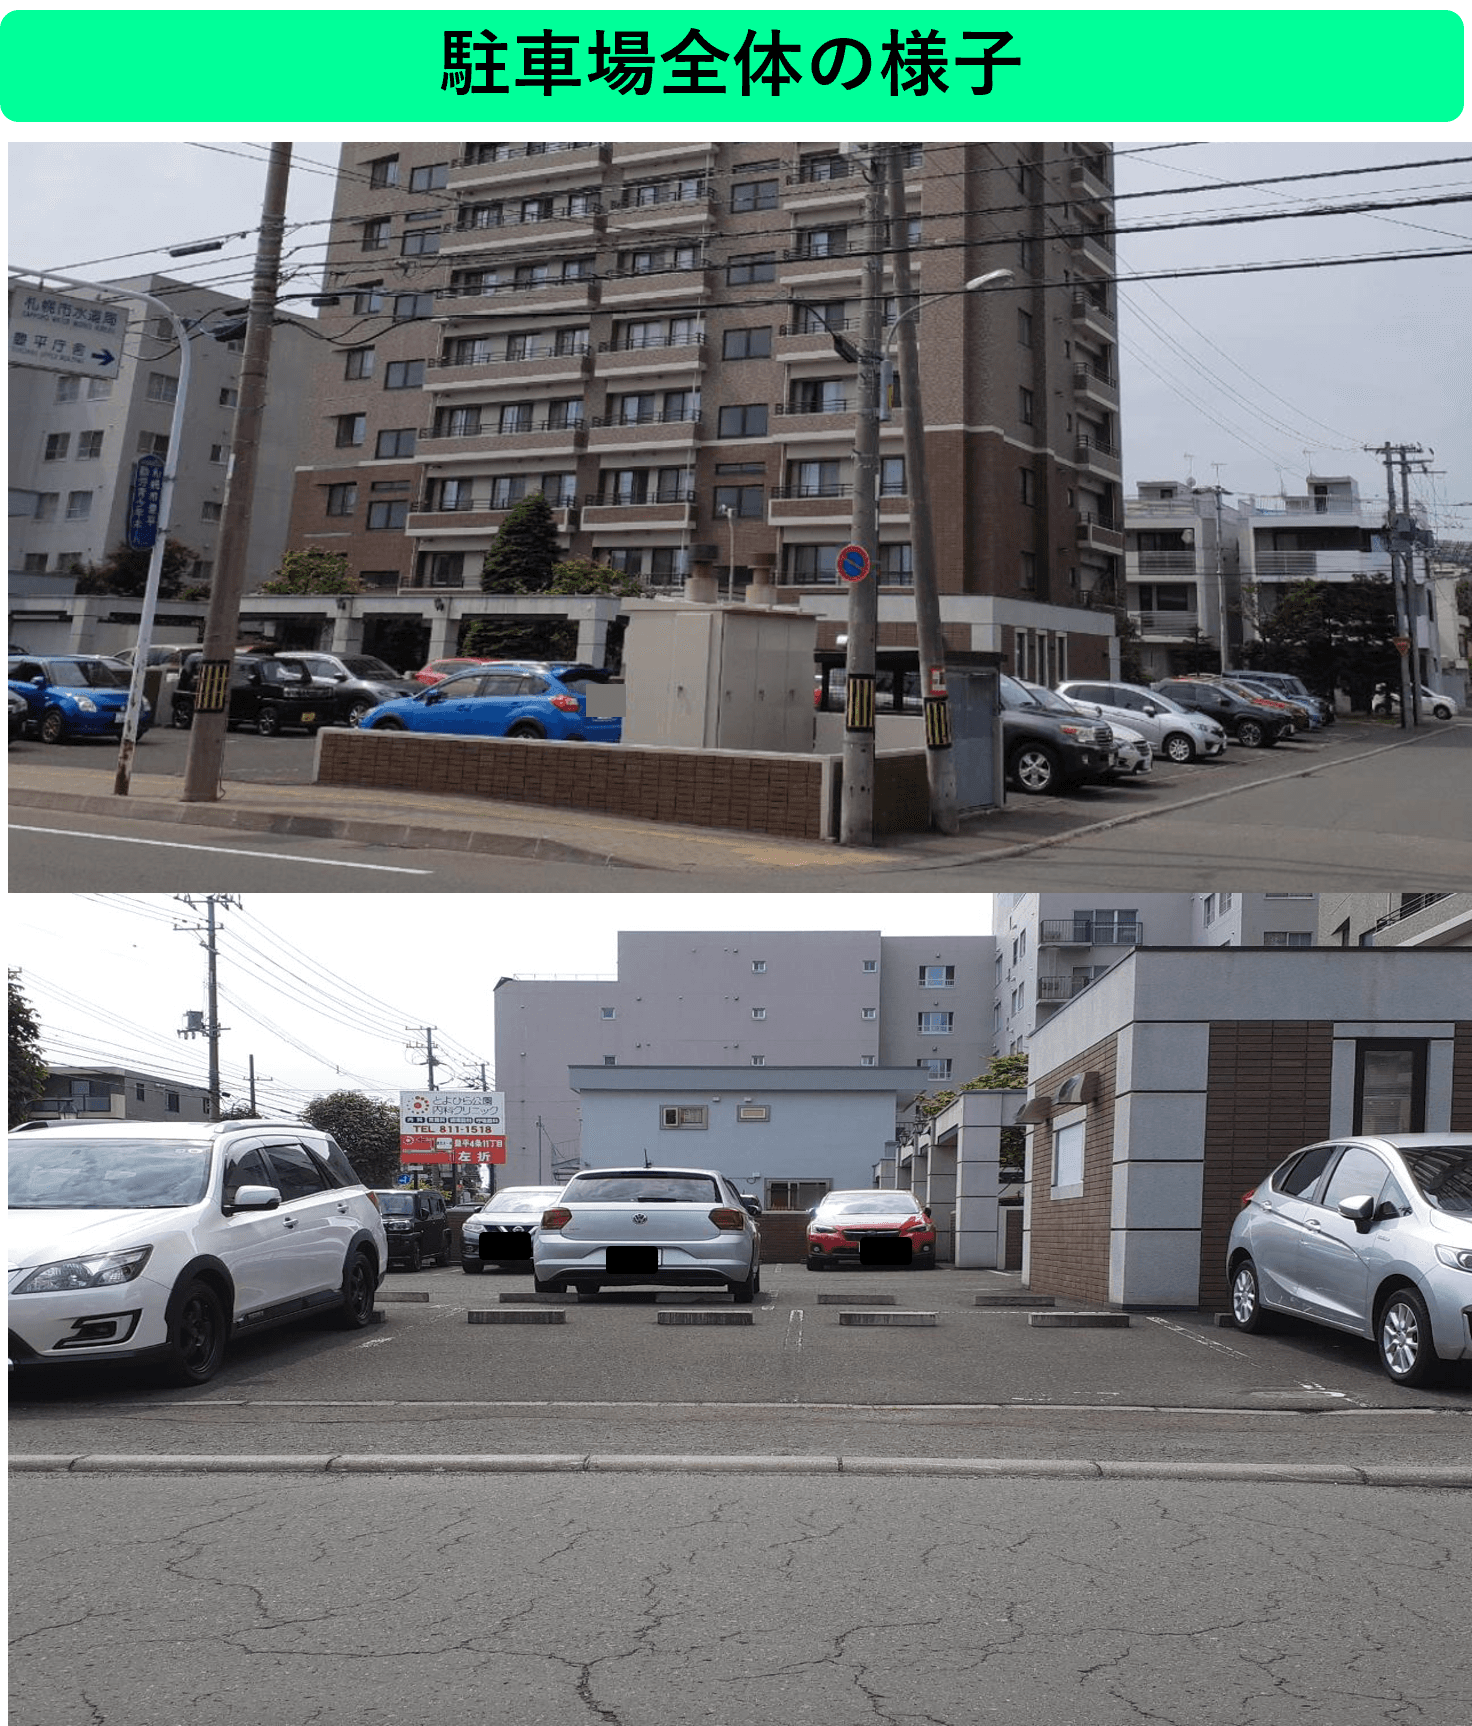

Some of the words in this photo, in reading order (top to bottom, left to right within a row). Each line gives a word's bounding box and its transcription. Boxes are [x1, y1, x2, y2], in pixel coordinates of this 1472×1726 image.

[24, 297, 118, 326] 札幌市水道局
[432, 1096, 492, 1105] とよひら公園
[432, 1106, 498, 1115] 内科クリニック
[413, 1125, 435, 1133] TEL
[439, 1125, 492, 1133] 811-1518
[458, 1151, 491, 1162] 左折
